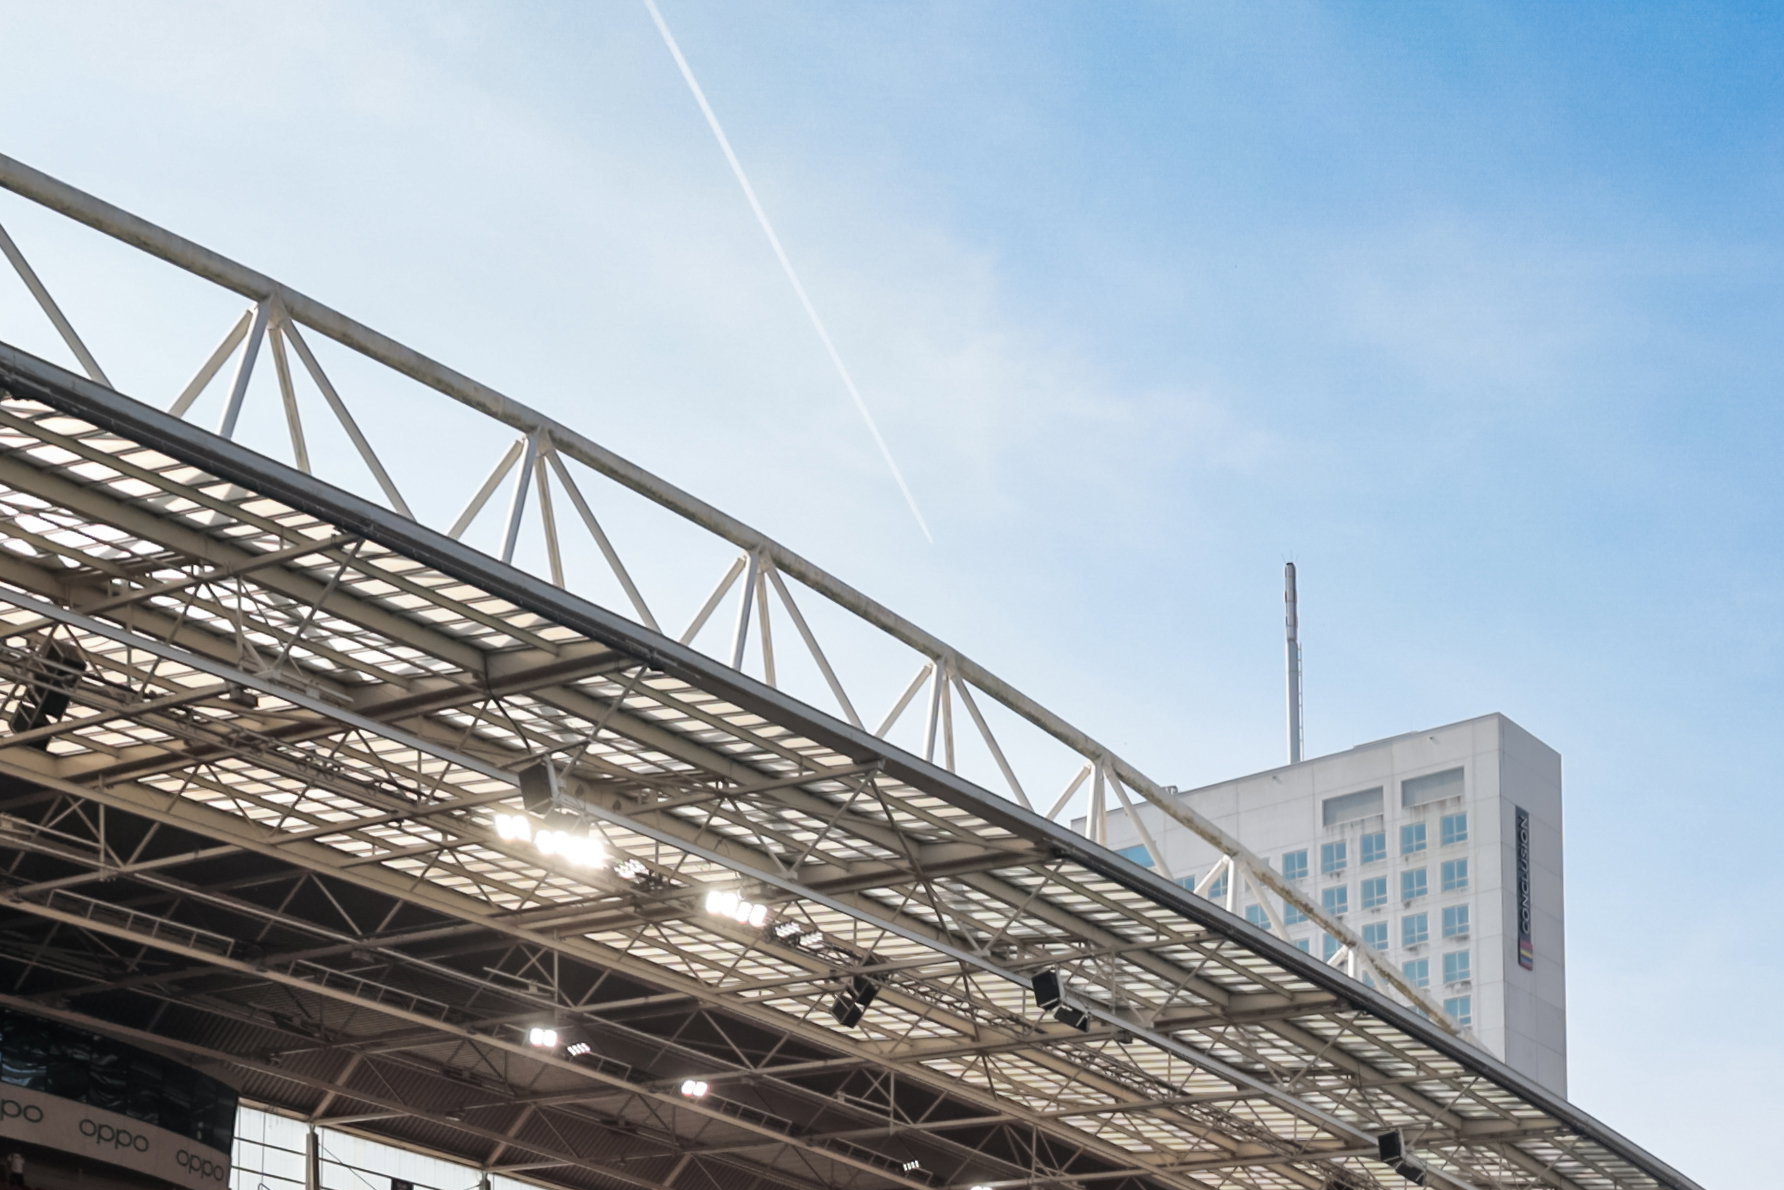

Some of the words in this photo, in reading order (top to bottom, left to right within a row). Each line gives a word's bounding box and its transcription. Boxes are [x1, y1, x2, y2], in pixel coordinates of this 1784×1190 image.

[1520, 815, 1531, 935] CONCLUSION
[79, 1118, 149, 1152] oppo
[176, 1149, 224, 1181] oppo
